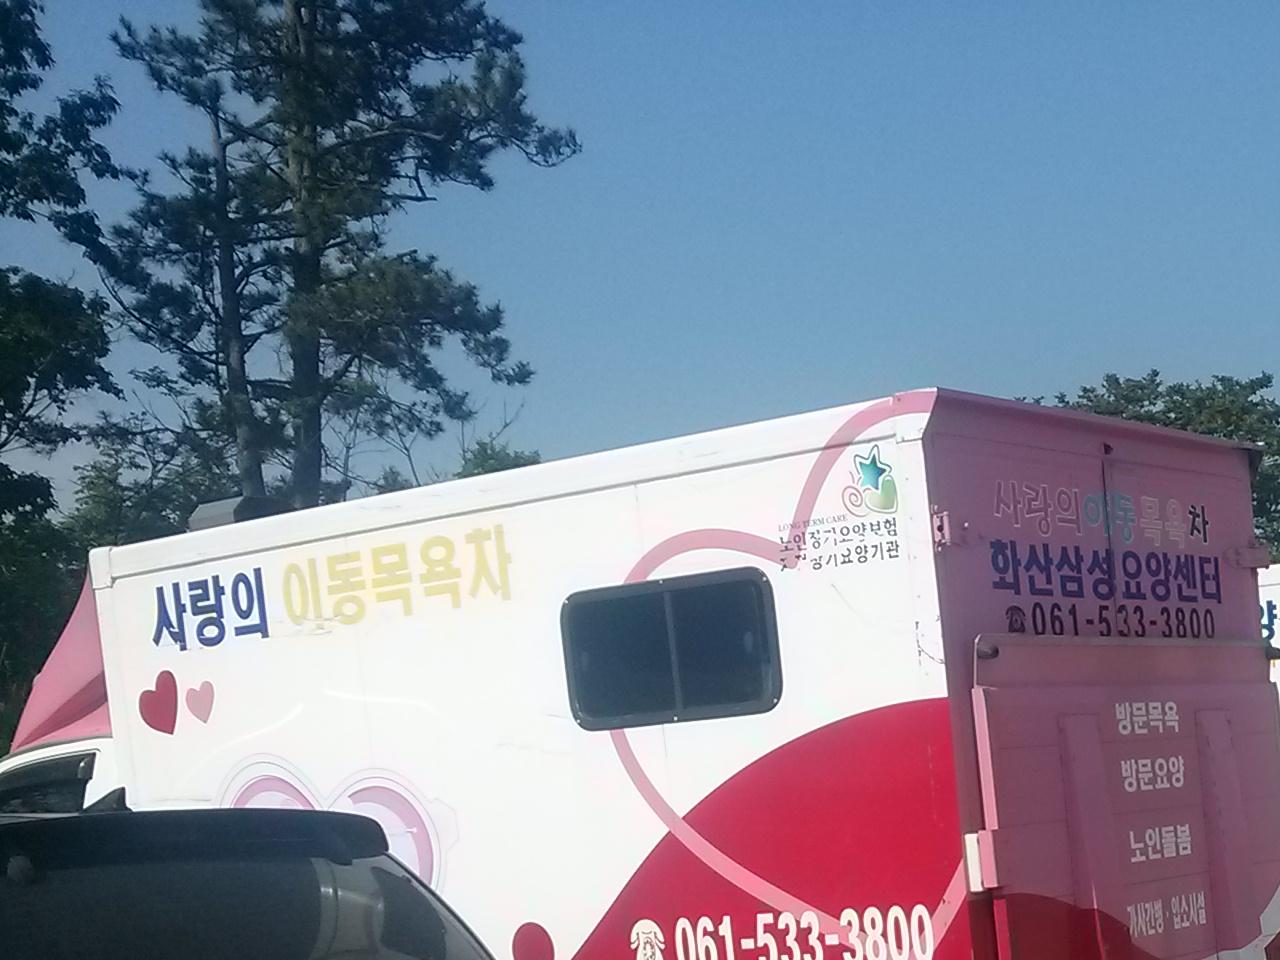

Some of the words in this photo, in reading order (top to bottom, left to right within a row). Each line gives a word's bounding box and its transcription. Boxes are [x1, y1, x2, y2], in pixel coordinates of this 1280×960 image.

[994, 480, 1082, 536] 사랑의
[152, 567, 270, 651] 사랑의
[282, 524, 513, 625] 이동목욕차
[990, 539, 1222, 604] 화산삼성요양센터
[1031, 602, 1215, 639] 061-533-3800
[1115, 701, 1179, 735] 방문목욕
[1120, 755, 1185, 792] 방문요양
[1129, 823, 1192, 863] 노인돌봄
